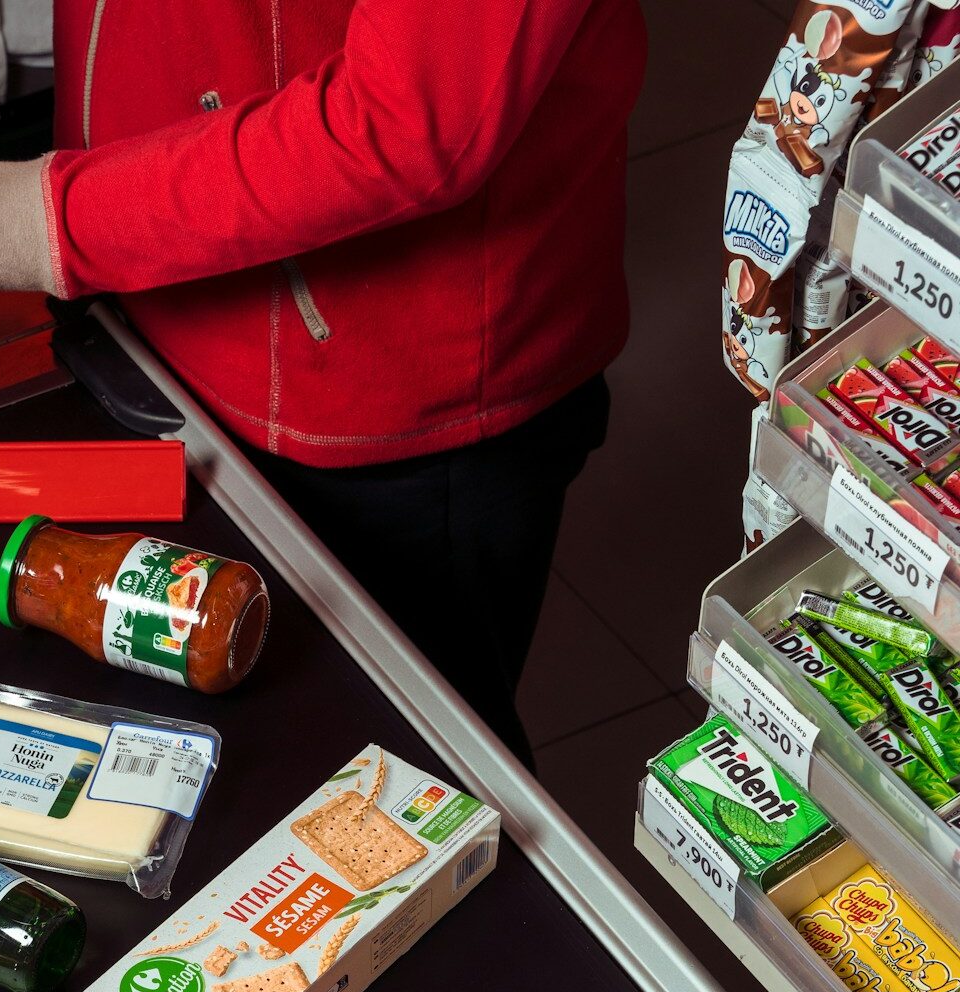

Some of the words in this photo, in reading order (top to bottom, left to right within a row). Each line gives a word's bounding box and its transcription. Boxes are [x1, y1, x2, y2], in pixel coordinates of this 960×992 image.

[906, 116, 960, 171] Dirol
[893, 260, 953, 319] 1,250
[878, 406, 949, 449] Dirol
[840, 478, 856, 495] Бохь
[869, 505, 908, 541] клубничная
[907, 538, 932, 562] поляна
[864, 527, 920, 588] 1,250
[857, 581, 914, 622] Dirol
[773, 634, 837, 679] Dirol
[721, 652, 735, 668] Бохь
[734, 666, 747, 679] Dirol
[746, 678, 776, 708] морожная
[776, 706, 790, 722] мята
[893, 668, 951, 718] Dirol
[133, 732, 173, 745] Carrefour
[743, 698, 791, 755] 1,250
[11, 744, 54, 761] Honin
[11, 754, 45, 770] Nuga
[176, 775, 200, 788] 17760
[700, 730, 797, 820] Trident
[395, 789, 423, 814] NUTRI-SCORE
[678, 811, 694, 831] Trident
[676, 829, 722, 888] 7,900
[734, 835, 766, 866] SPEARMINT
[222, 853, 306, 924] VITALITY
[848, 889, 889, 911] Chupa
[265, 882, 331, 938] SÉSAME
[295, 903, 332, 936] SESAM
[839, 899, 879, 924] Chups
[803, 921, 843, 944] Chupa
[863, 927, 878, 938] Big
